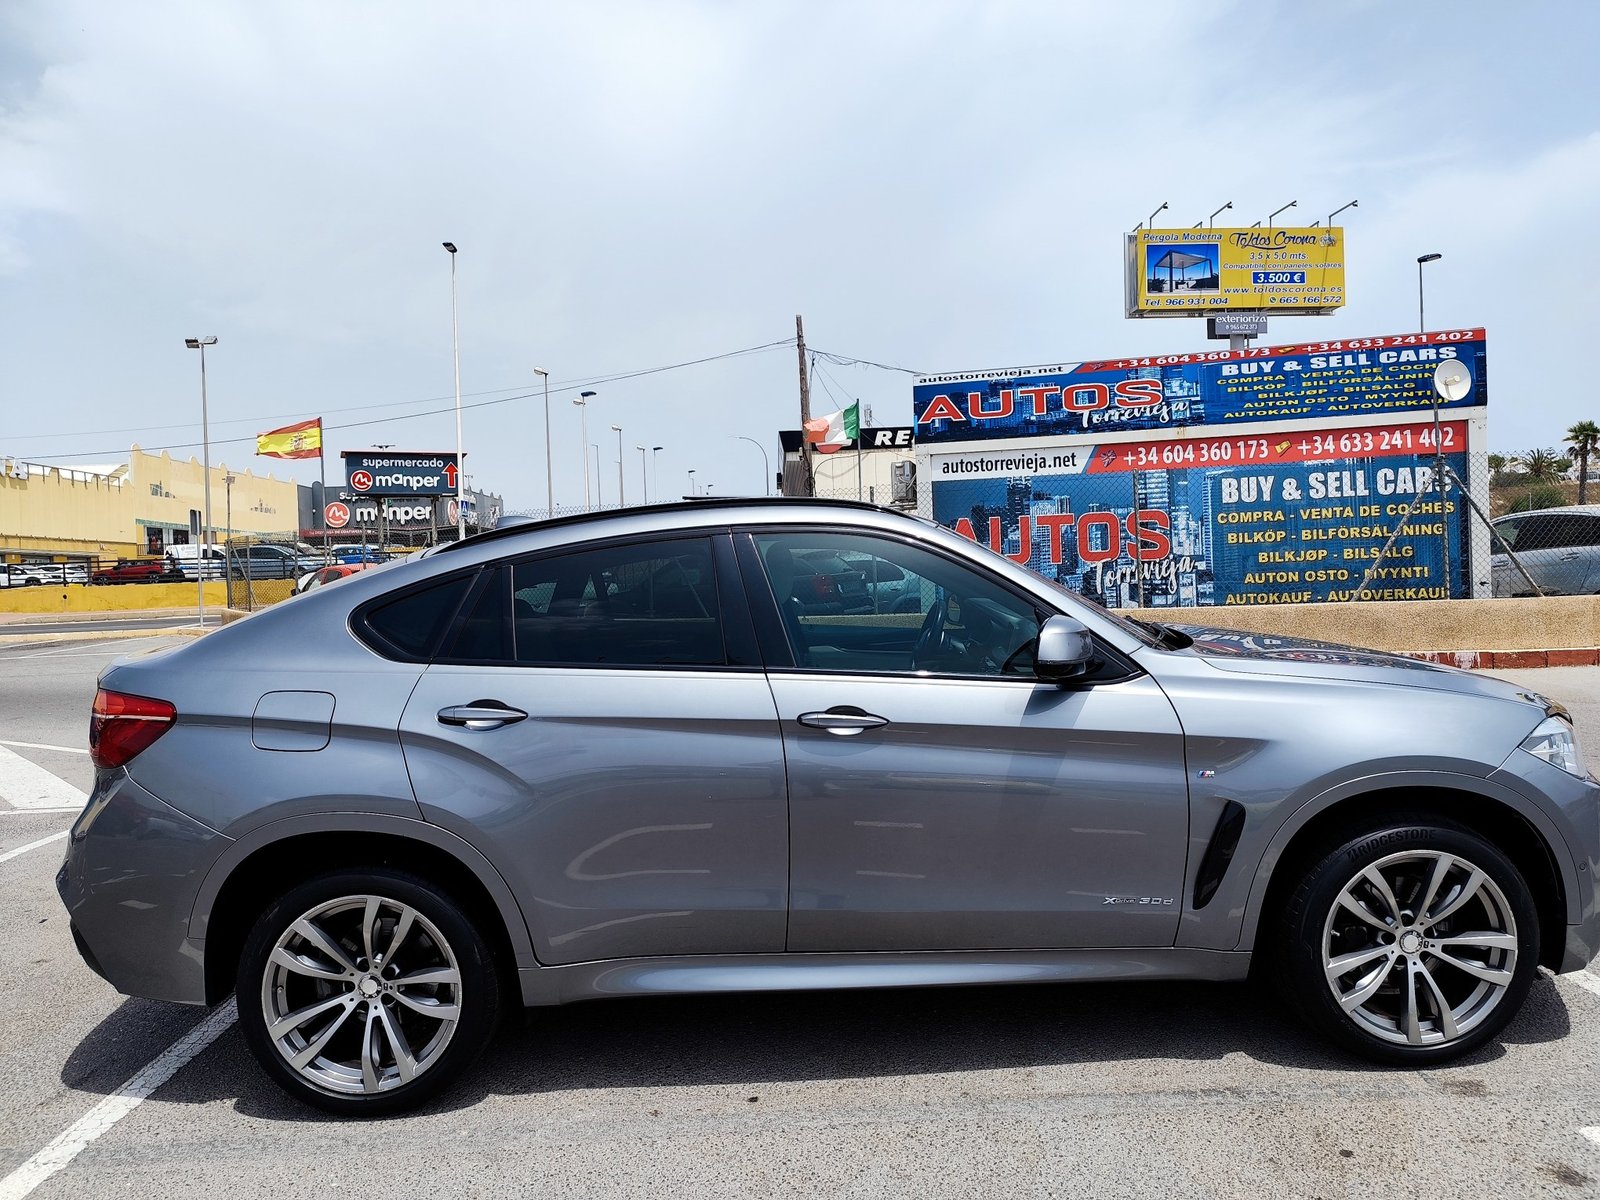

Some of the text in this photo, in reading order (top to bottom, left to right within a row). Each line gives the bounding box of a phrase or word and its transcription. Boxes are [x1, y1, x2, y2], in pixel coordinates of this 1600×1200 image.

[1143, 232, 1223, 242] Pergola Moderna
[1229, 231, 1317, 249] Toldos Corona
[1249, 252, 1263, 260] 3,5
[1273, 252, 1287, 260] 5,0
[1283, 262, 1313, 270] paneles
[1257, 273, 1302, 283] 3.500 €
[1144, 297, 1229, 306] Tel. 966 931 004
[1279, 295, 1342, 304] 665 166 572
[1216, 314, 1267, 323] exterioriza
[1302, 331, 1474, 352] +34 633 241 402
[1113, 348, 1271, 368] +34 604 360 173
[1221, 346, 1457, 376] BUY & SELL CARS
[919, 365, 1064, 384] autostorrevieja.net
[1217, 374, 1286, 385] COMPRA
[1300, 369, 1355, 378] VENTA
[1227, 383, 1286, 393] BILKÖP
[1258, 388, 1328, 399] BILKJØP
[1343, 382, 1416, 393] BILSALG
[917, 378, 1163, 425] AUTOS
[1243, 399, 1299, 409] AUTON
[1365, 390, 1432, 400] MYYNTI
[1075, 401, 1190, 429] Torrevieja
[1223, 407, 1312, 419] AUTOKAUF
[1297, 427, 1454, 455] +34 633 241 402
[1123, 439, 1269, 466] +34 604 360 173
[362, 457, 444, 469] supermercado
[942, 452, 1077, 474] autostorrevieja.net
[375, 473, 440, 491] manper
[1221, 469, 1275, 504] BUY
[1281, 476, 1302, 501] &
[1308, 468, 1369, 499] SELL
[1217, 510, 1285, 524] COMPRA
[1300, 506, 1355, 520] VENTA
[1359, 505, 1381, 517] DE
[1227, 528, 1286, 544] BILKÖP
[1301, 523, 1443, 541] BILFÖRSÄLNING
[1258, 549, 1328, 563] BILKJØP
[1244, 571, 1299, 584] AUTON
[1304, 569, 1349, 582] OSTO
[1225, 591, 1312, 605] AUTOKAUF
[1347, 829, 1437, 860] BRIDGESTONE
[1139, 897, 1174, 905] 30d
